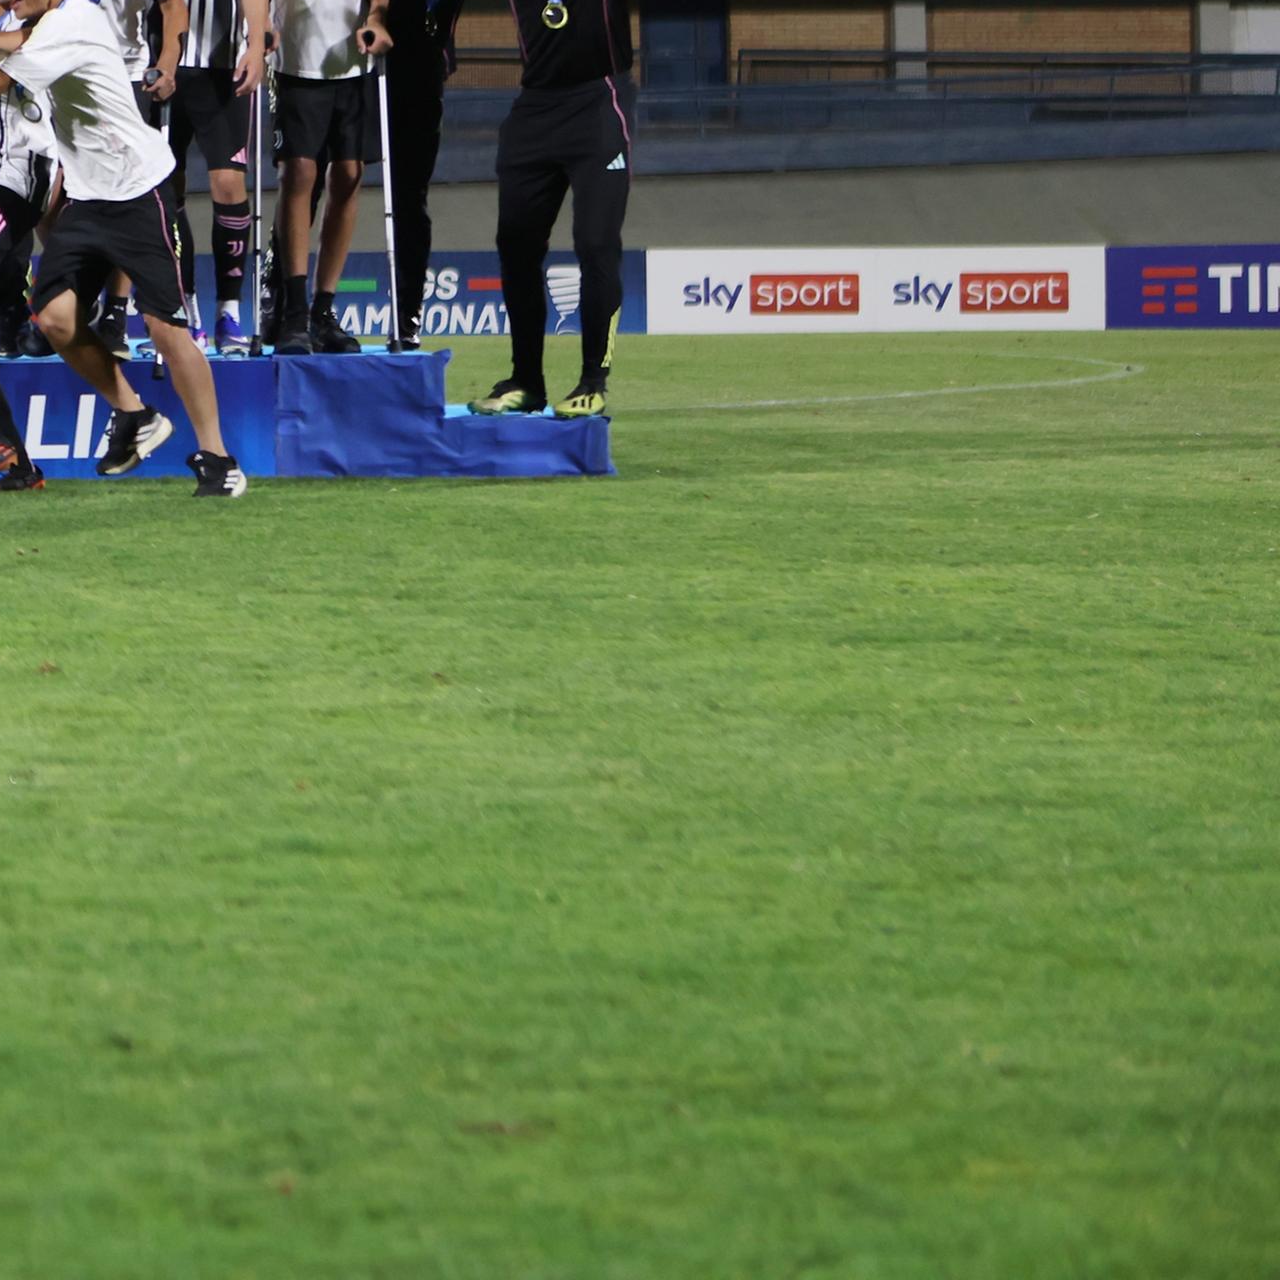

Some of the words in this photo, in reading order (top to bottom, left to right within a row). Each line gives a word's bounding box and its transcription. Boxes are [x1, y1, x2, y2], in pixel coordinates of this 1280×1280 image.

[683, 276, 744, 313] sky
[756, 278, 853, 311] sport
[893, 275, 953, 312] sky
[966, 276, 1062, 309] sport
